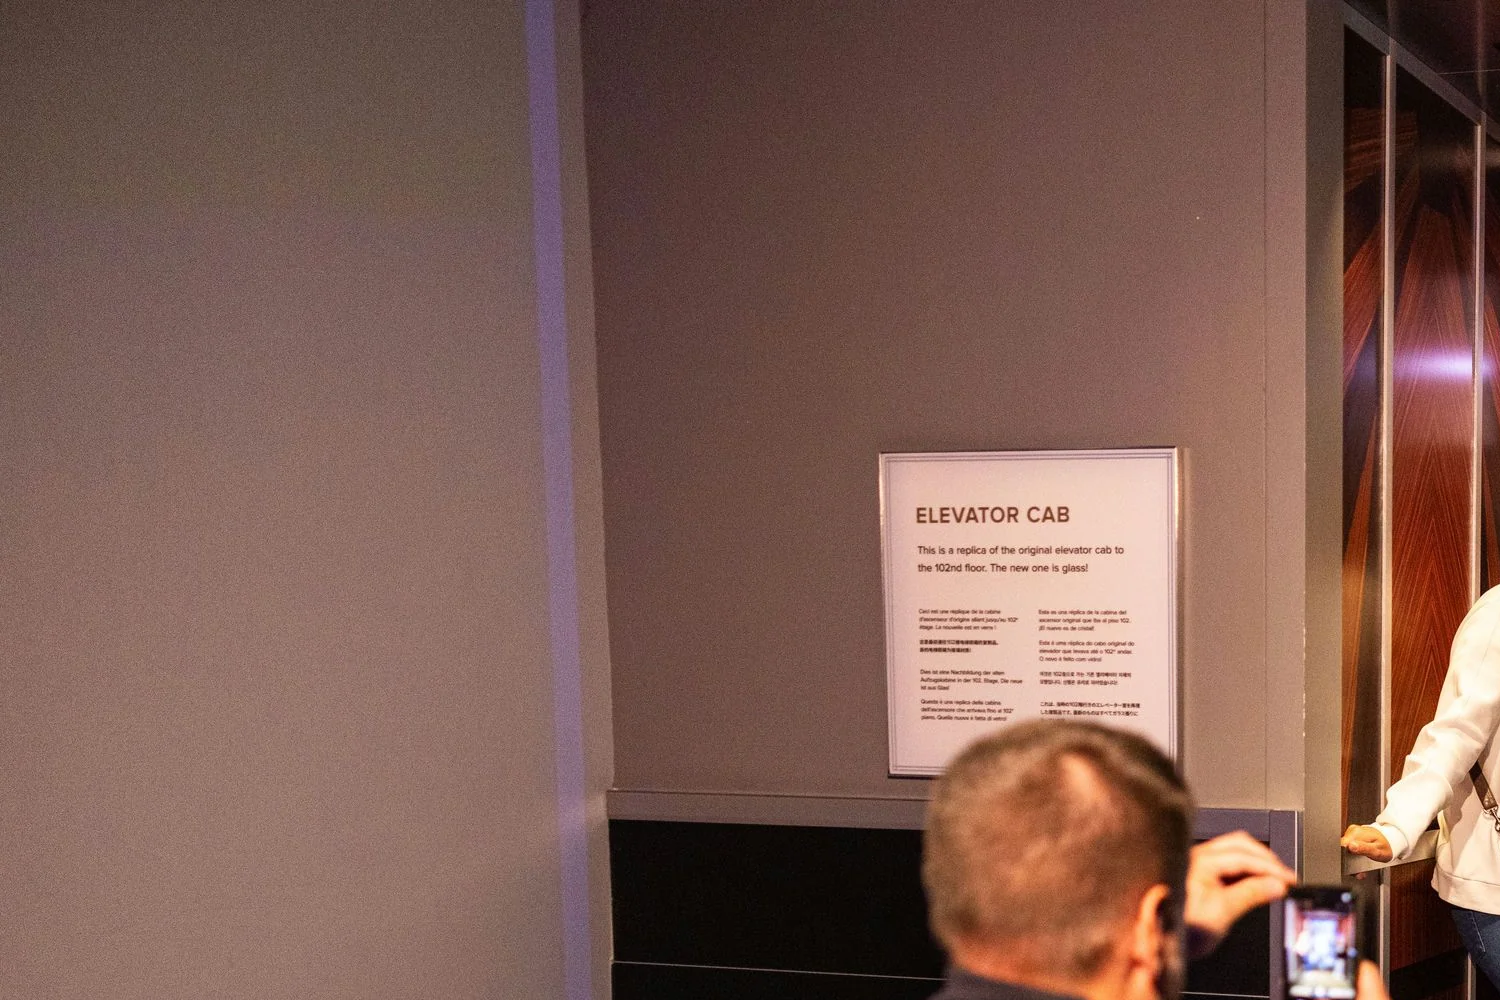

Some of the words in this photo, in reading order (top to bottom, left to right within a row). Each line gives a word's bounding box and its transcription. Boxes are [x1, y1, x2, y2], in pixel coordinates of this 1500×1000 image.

[916, 507, 1019, 523] ELEVATOR
[1027, 506, 1070, 523] CAB
[917, 545, 936, 555] This
[938, 545, 946, 555] is
[948, 547, 954, 555] a
[956, 546, 987, 557] replica
[989, 545, 999, 555] of
[1001, 545, 1016, 555] the
[1018, 546, 1052, 557] original
[1055, 545, 1092, 555] elevator
[1095, 546, 1112, 555] cab
[1114, 546, 1124, 555] to
[917, 563, 932, 573] the
[935, 563, 962, 573] 102nd
[965, 563, 987, 573] floor.
[990, 563, 1007, 573] The
[1009, 565, 1029, 573] new
[1031, 565, 1049, 573] one
[1051, 563, 1060, 573] is
[1062, 563, 1089, 575] glass!
